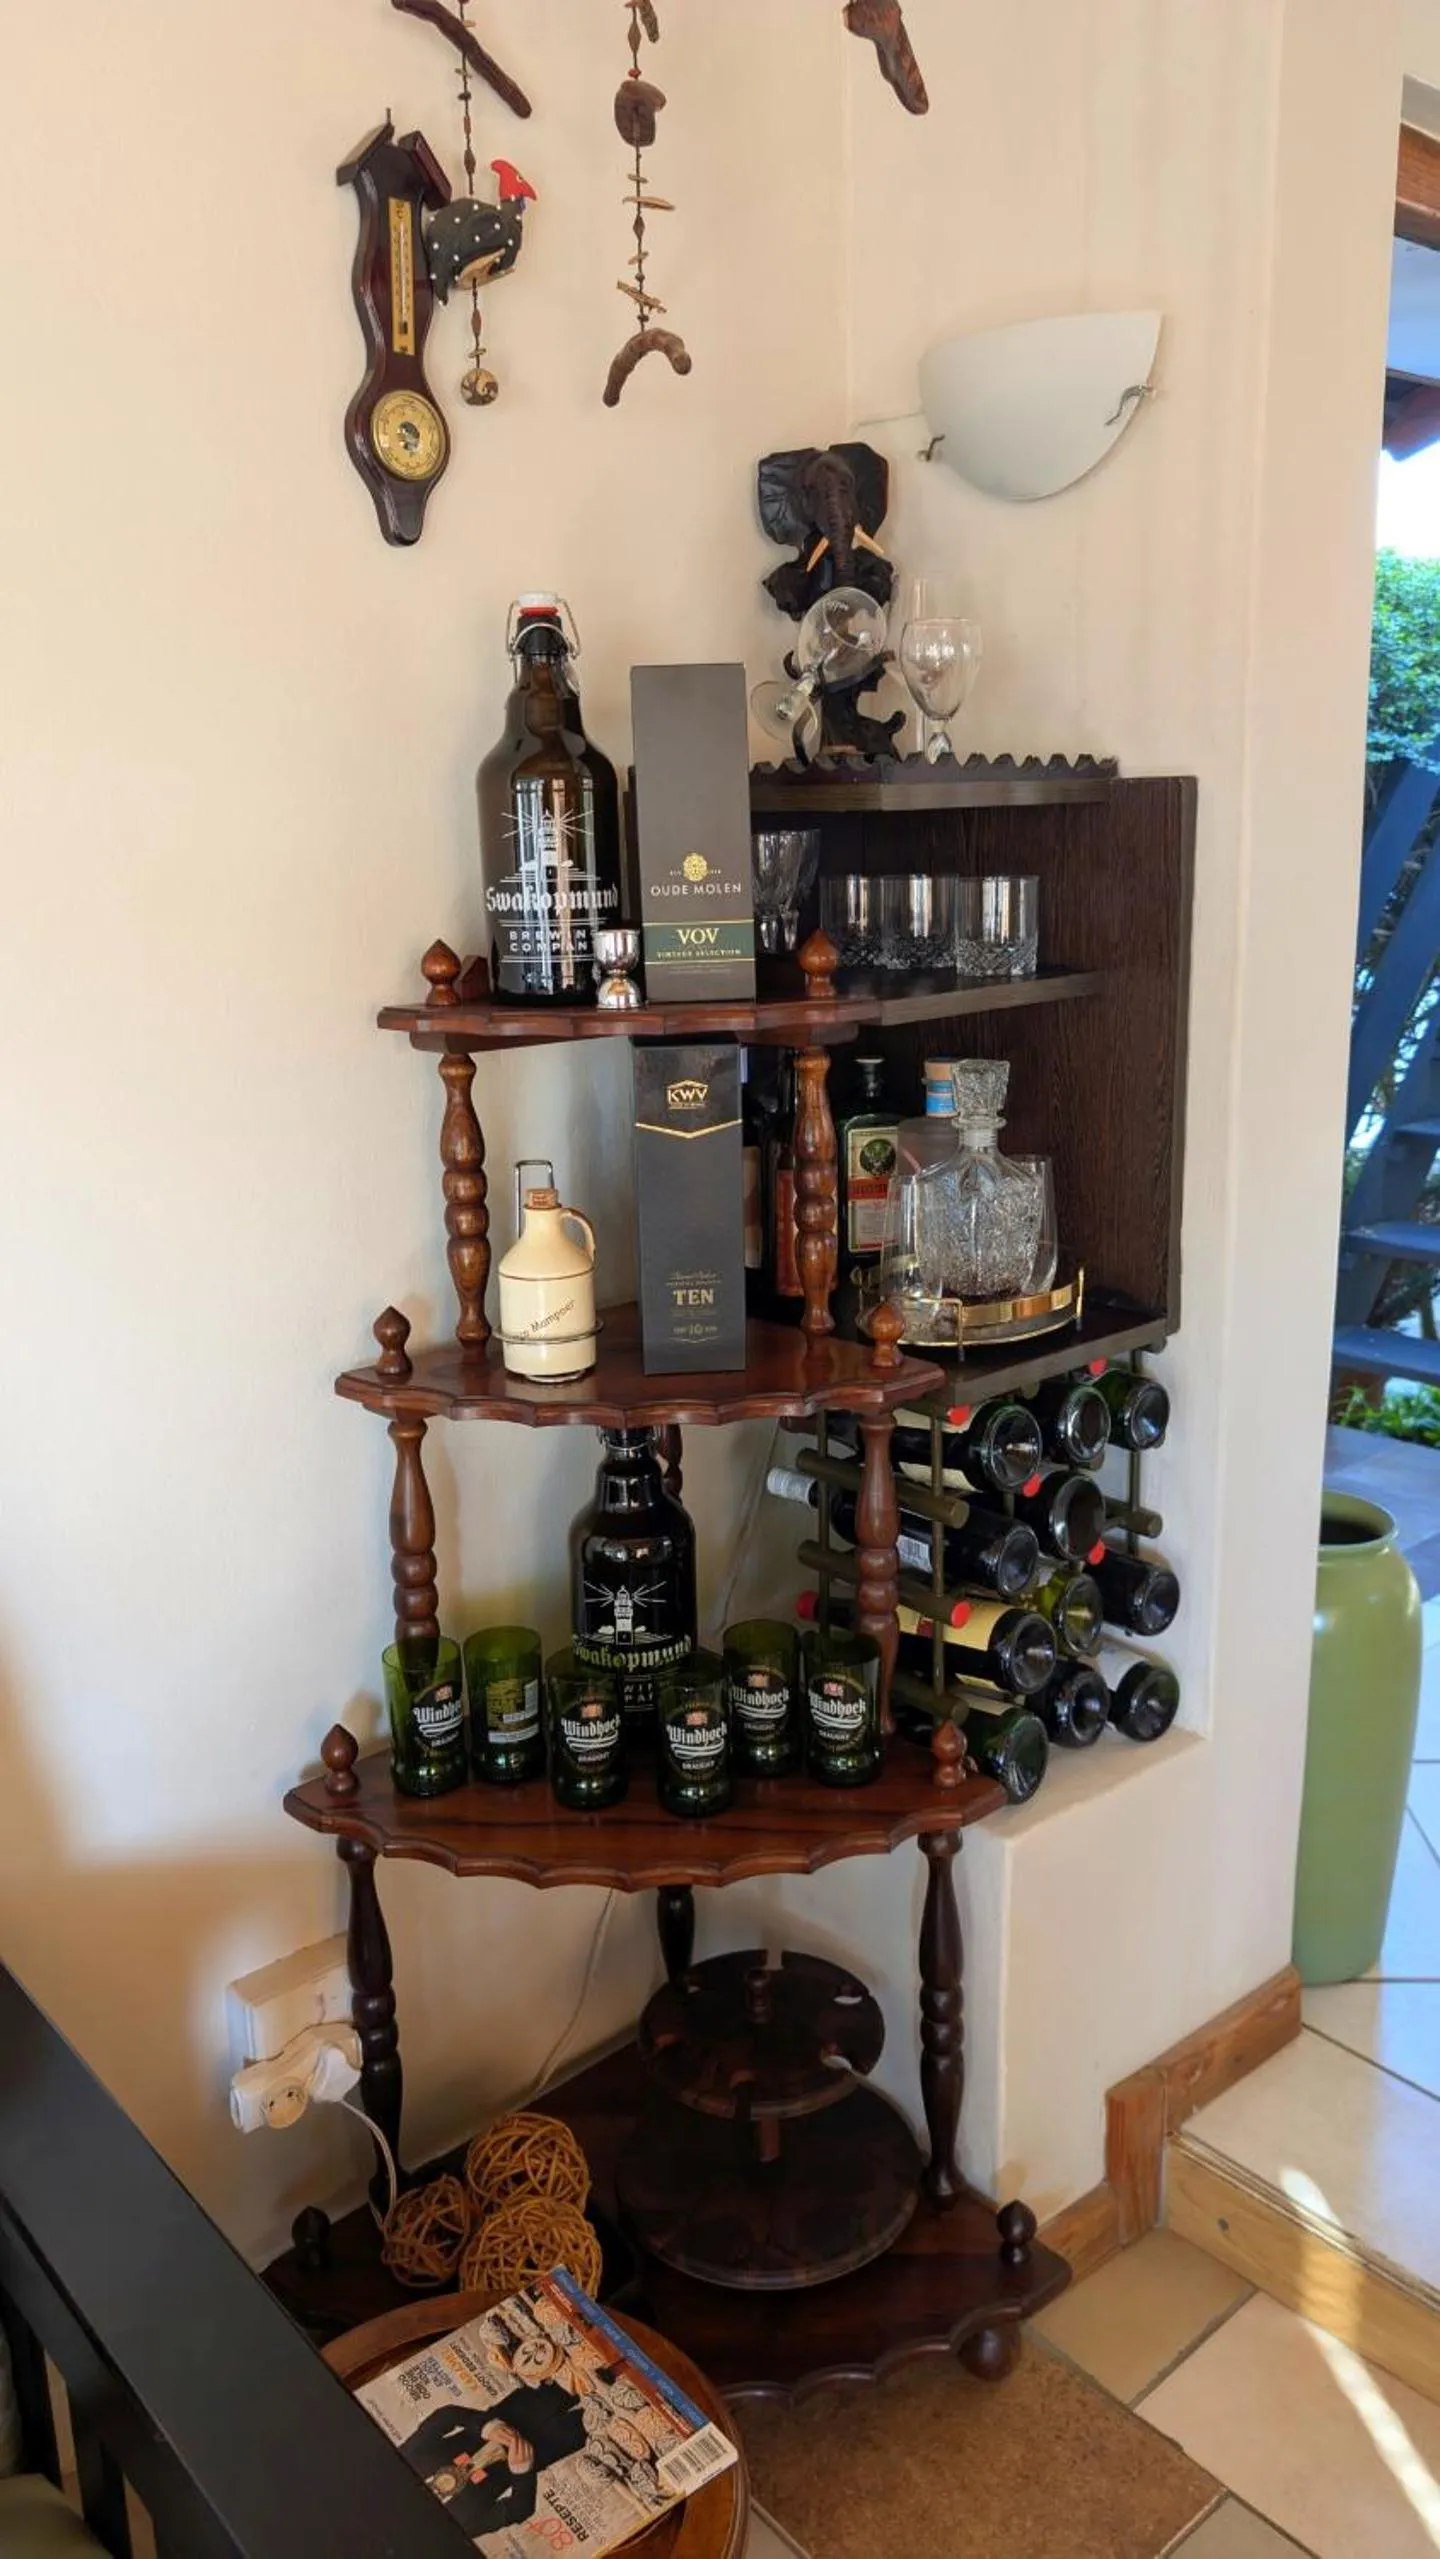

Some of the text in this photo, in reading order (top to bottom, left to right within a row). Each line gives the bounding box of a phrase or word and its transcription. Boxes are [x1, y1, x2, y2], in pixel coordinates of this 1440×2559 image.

[651, 883, 741, 896] OUDE MOLEN
[486, 882, 618, 916] Swakopmund
[510, 929, 586, 940] BREWIN
[677, 927, 720, 944] VOV
[510, 940, 588, 952] COMPAN
[667, 1086, 708, 1103] KWV
[673, 1288, 714, 1306] TEN
[543, 2485, 589, 2546] RESEPTE
